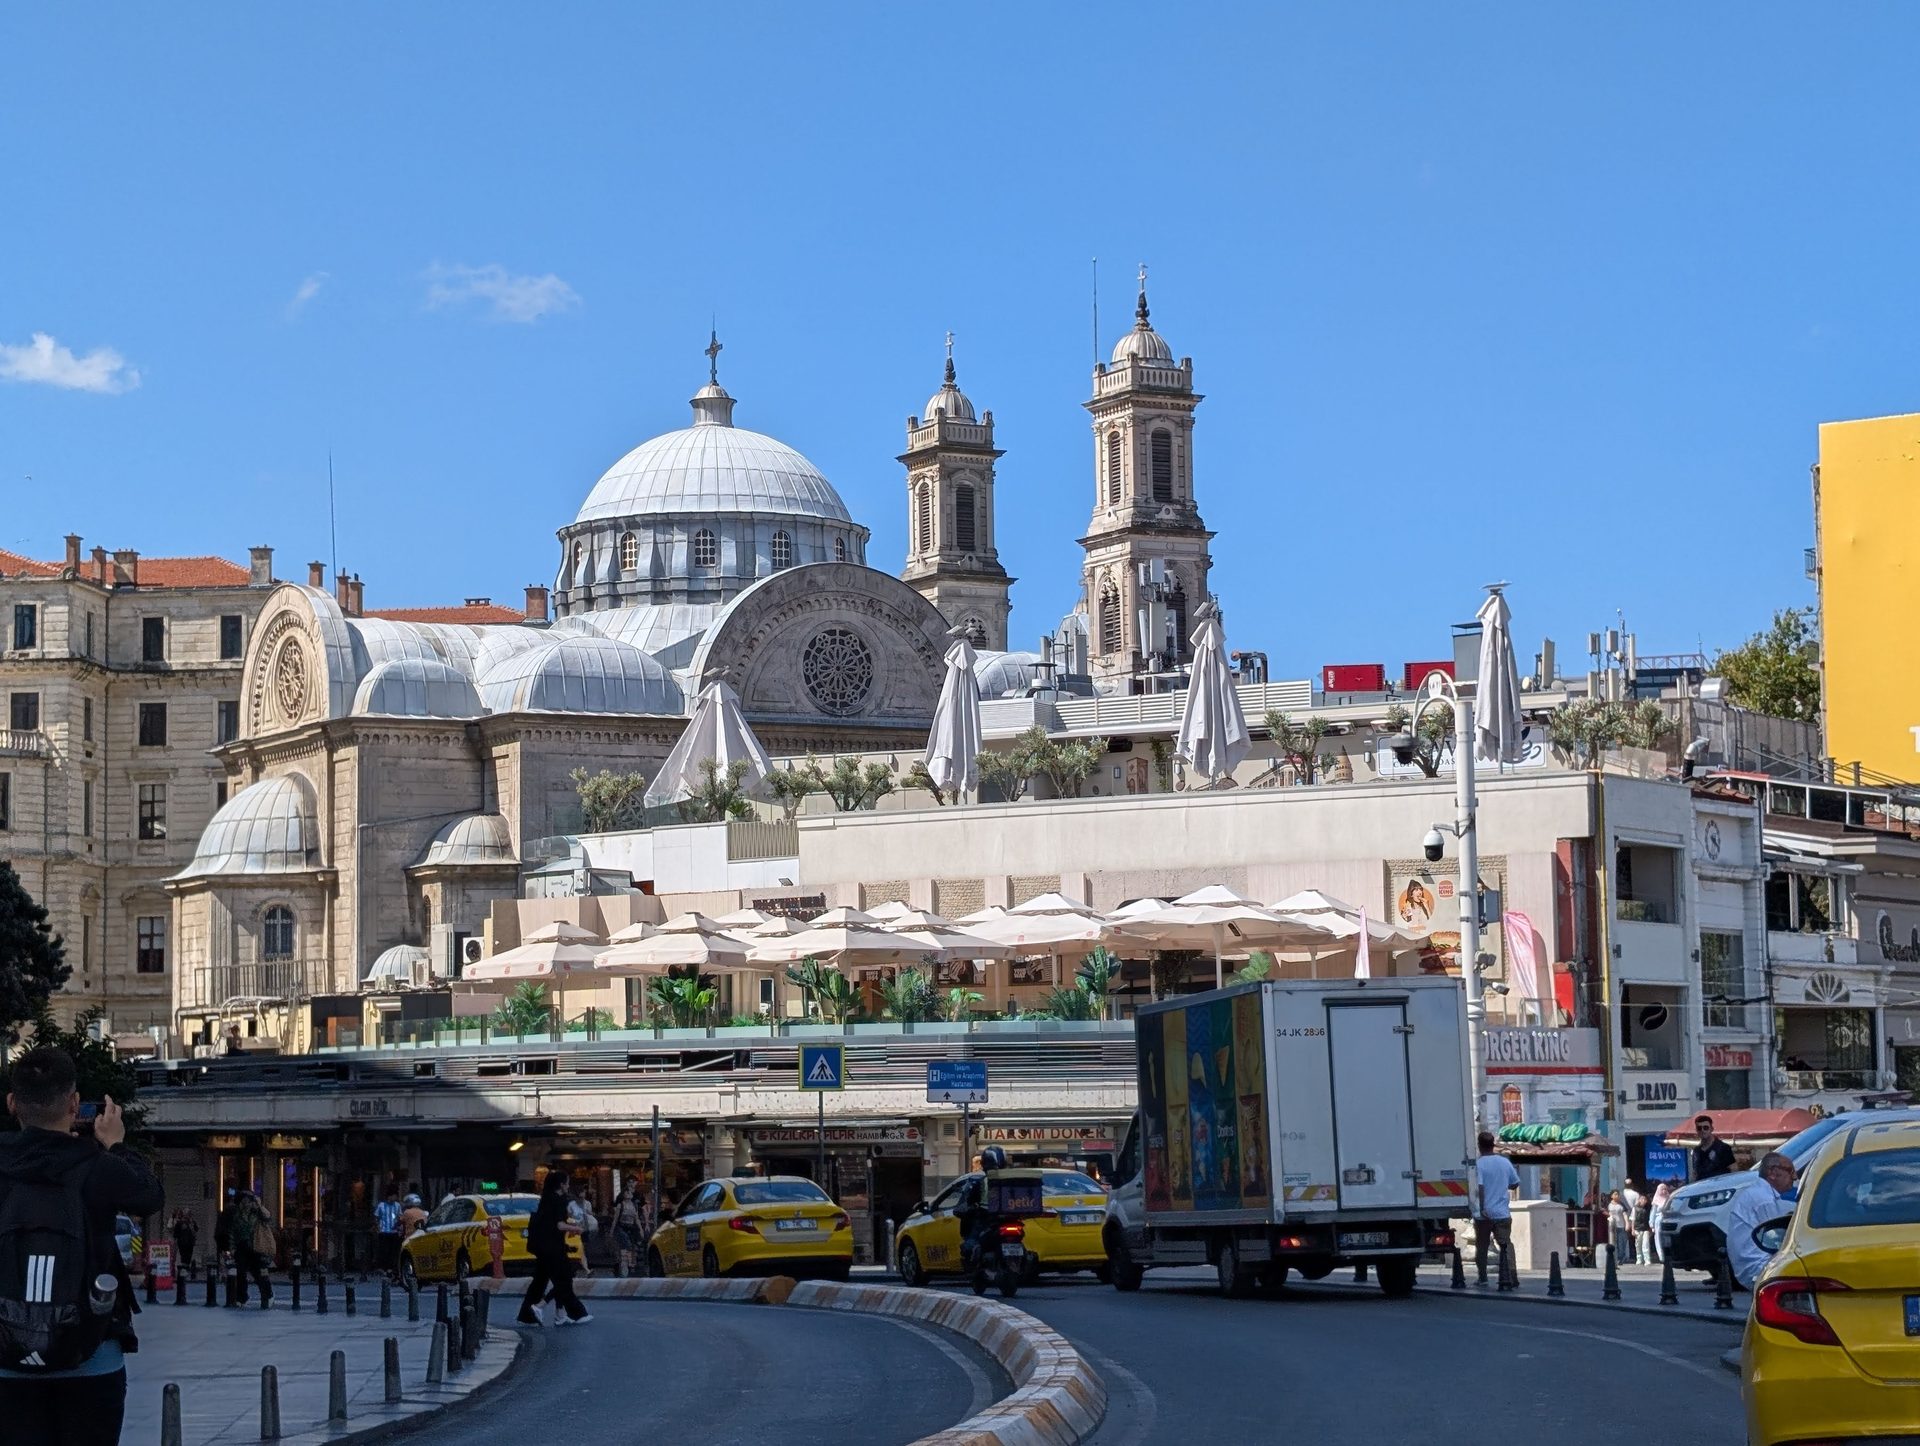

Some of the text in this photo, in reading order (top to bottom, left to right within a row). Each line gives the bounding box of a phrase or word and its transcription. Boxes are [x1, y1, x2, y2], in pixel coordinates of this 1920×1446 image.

[1276, 1028, 1287, 1037] 34
[1289, 1028, 1302, 1037] JK
[1482, 1031, 1570, 1063] URGER KING
[1637, 1082, 1677, 1101] BRAVO
[1008, 1196, 1035, 1210] getir
